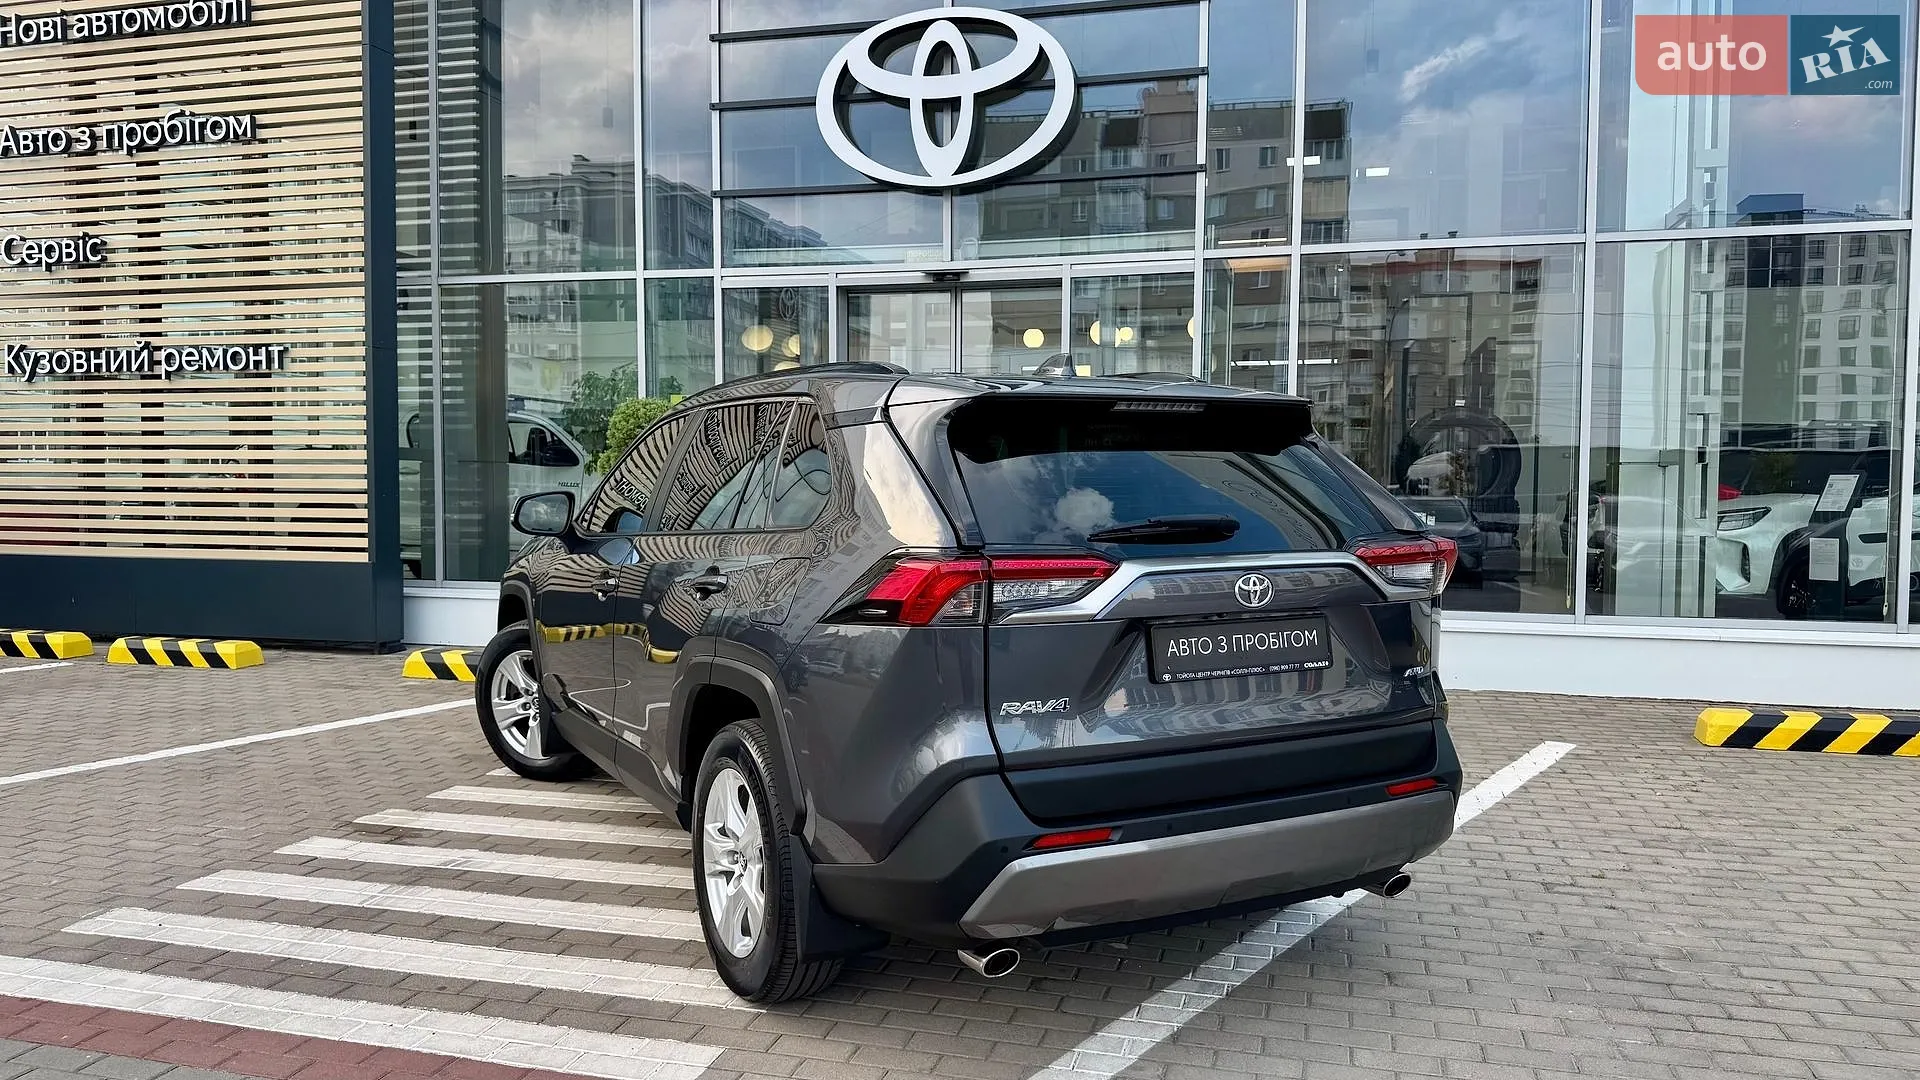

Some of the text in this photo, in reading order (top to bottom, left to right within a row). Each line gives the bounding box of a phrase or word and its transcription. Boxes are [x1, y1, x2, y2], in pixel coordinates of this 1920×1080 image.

[0, 0, 248, 44] Нові автомобілі
[0, 108, 253, 157] Авто з пробігом
[1, 230, 102, 272] Сервіс
[4, 340, 285, 382] Кузовний ремонт
[1167, 629, 1318, 657] АВТО З ПРОБІГОМ
[1176, 672, 1195, 680] ТОЙОТА
[1000, 697, 1070, 716] RAV4
